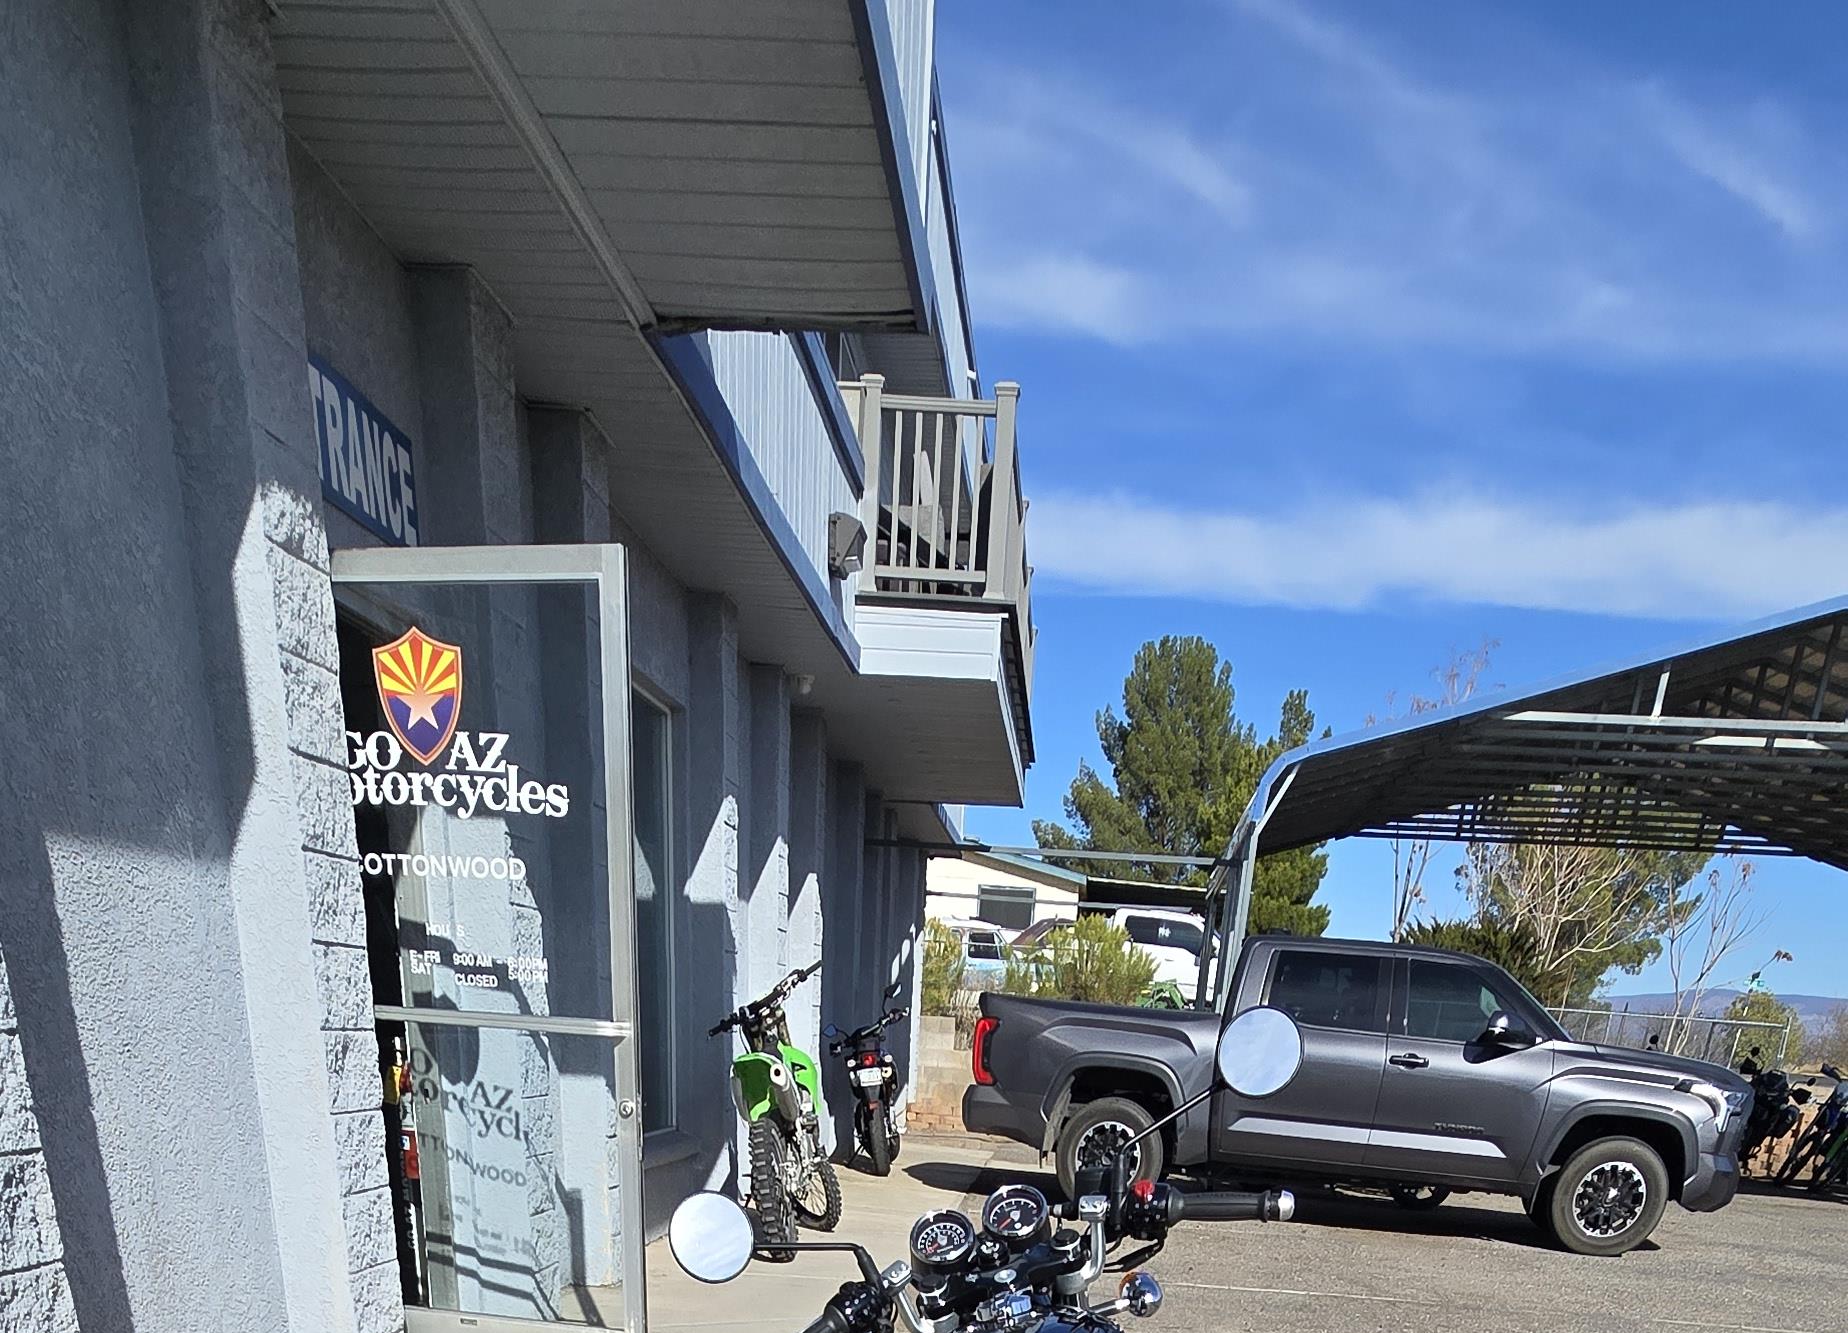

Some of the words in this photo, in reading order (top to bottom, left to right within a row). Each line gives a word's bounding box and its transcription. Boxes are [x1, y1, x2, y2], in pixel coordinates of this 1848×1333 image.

[446, 731, 510, 772] AZ
[360, 852, 527, 880] OTTONWOOD
[411, 962, 432, 975] SAT
[454, 973, 498, 988] CLOSED
